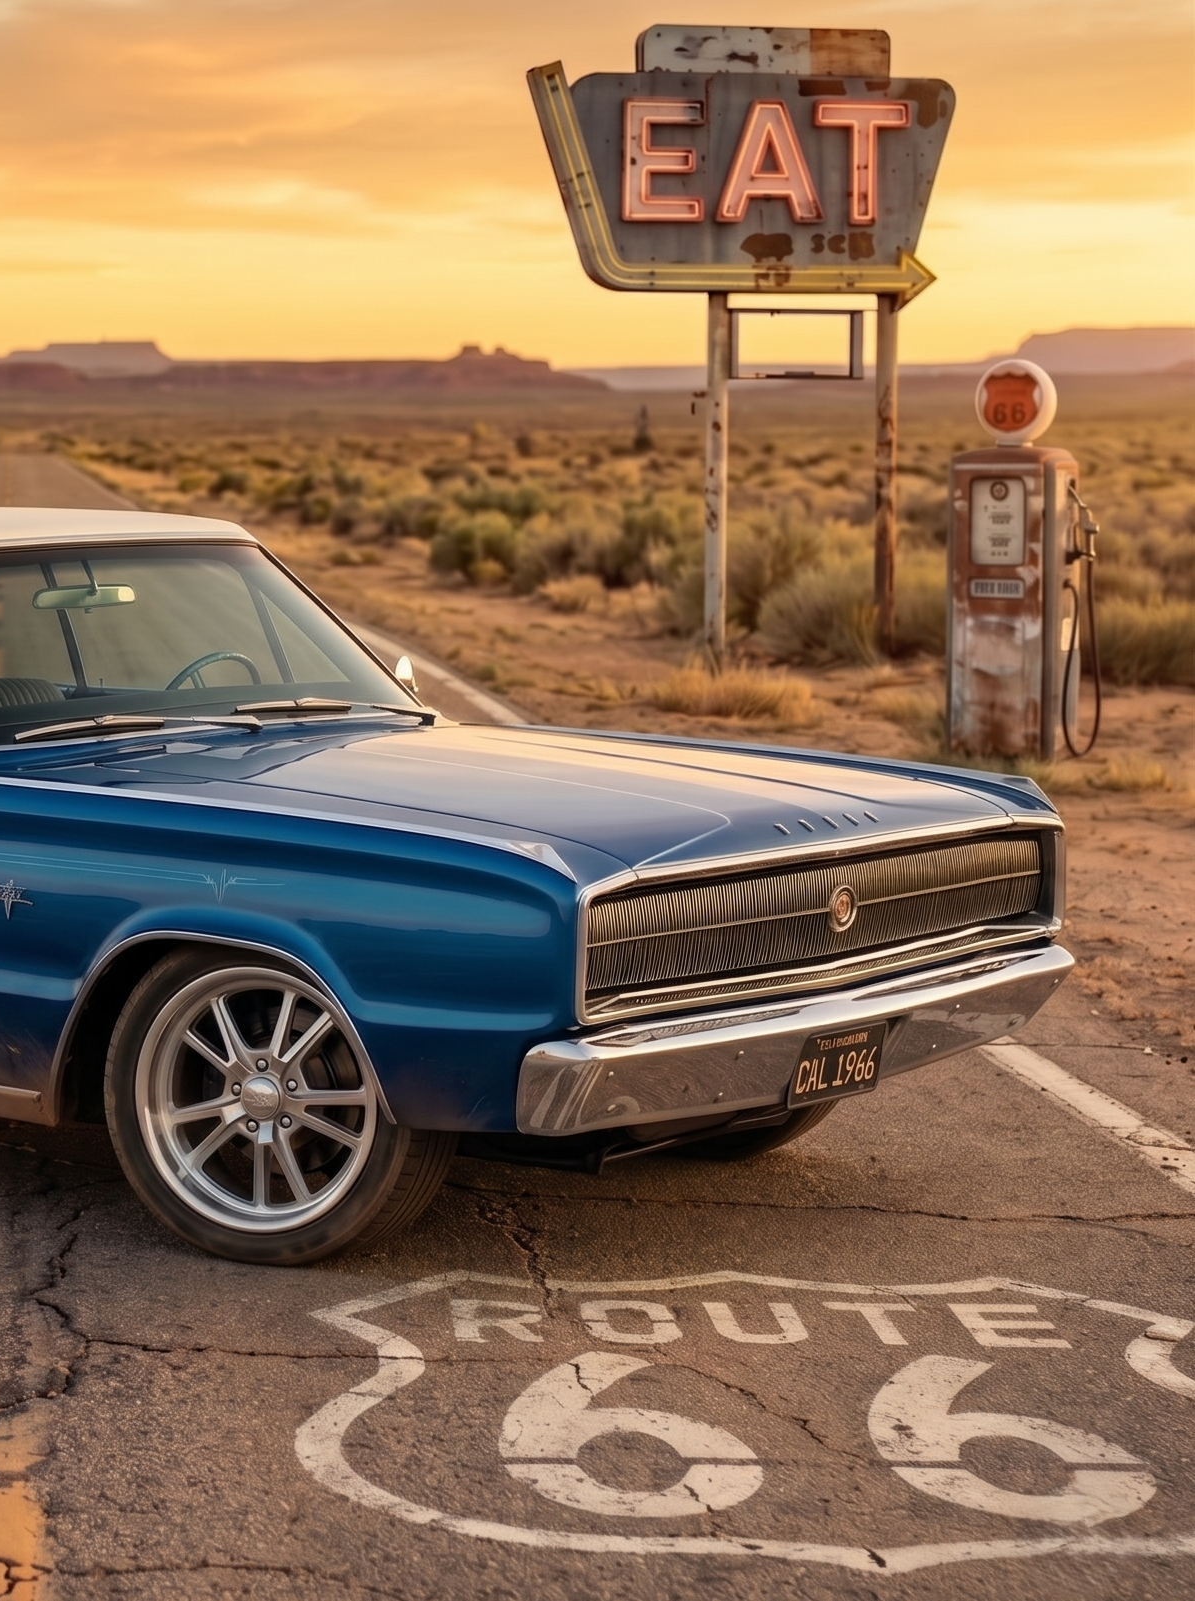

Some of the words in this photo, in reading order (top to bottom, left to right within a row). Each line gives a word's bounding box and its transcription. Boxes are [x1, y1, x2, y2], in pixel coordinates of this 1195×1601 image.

[621, 97, 912, 226] EAT
[993, 402, 1026, 425] 66
[795, 1056, 828, 1094] CAL
[832, 1046, 877, 1087] 1966
[450, 1298, 1072, 1349] ROUTE
[499, 1352, 1158, 1527] 66
